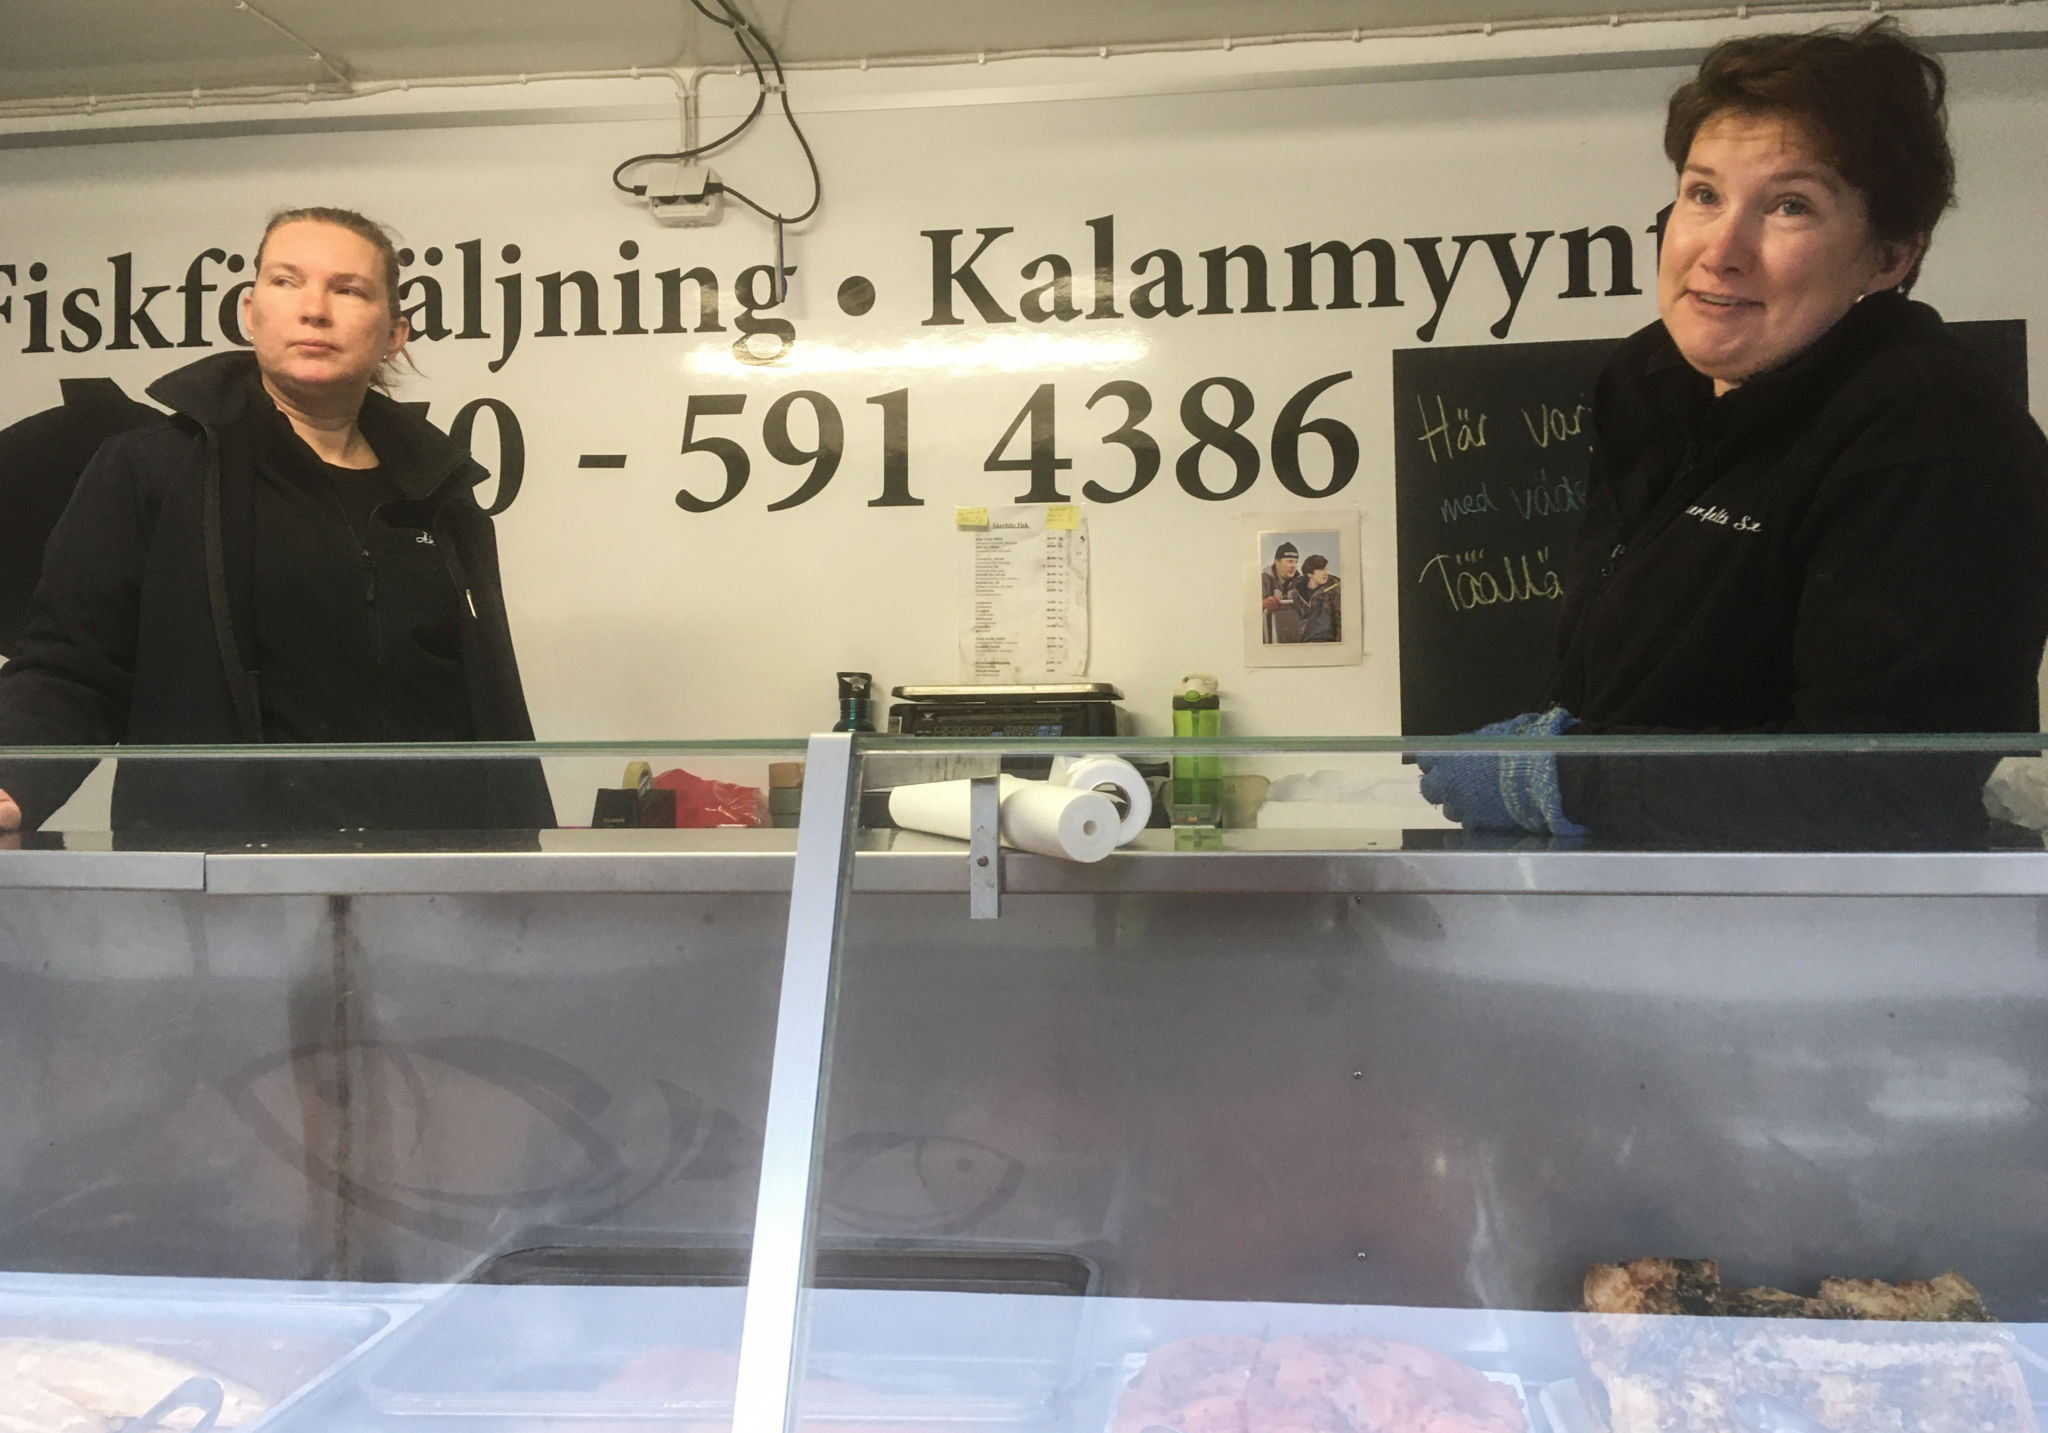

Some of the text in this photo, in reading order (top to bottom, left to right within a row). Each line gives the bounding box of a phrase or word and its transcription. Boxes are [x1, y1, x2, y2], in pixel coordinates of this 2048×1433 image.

[920, 201, 1676, 343] Kalanmyyn
[675, 387, 925, 513] 591
[983, 371, 1360, 504] 4386
[1416, 394, 1488, 463] Här
[1440, 481, 1499, 523] med
[1418, 546, 1564, 612] Täällä
